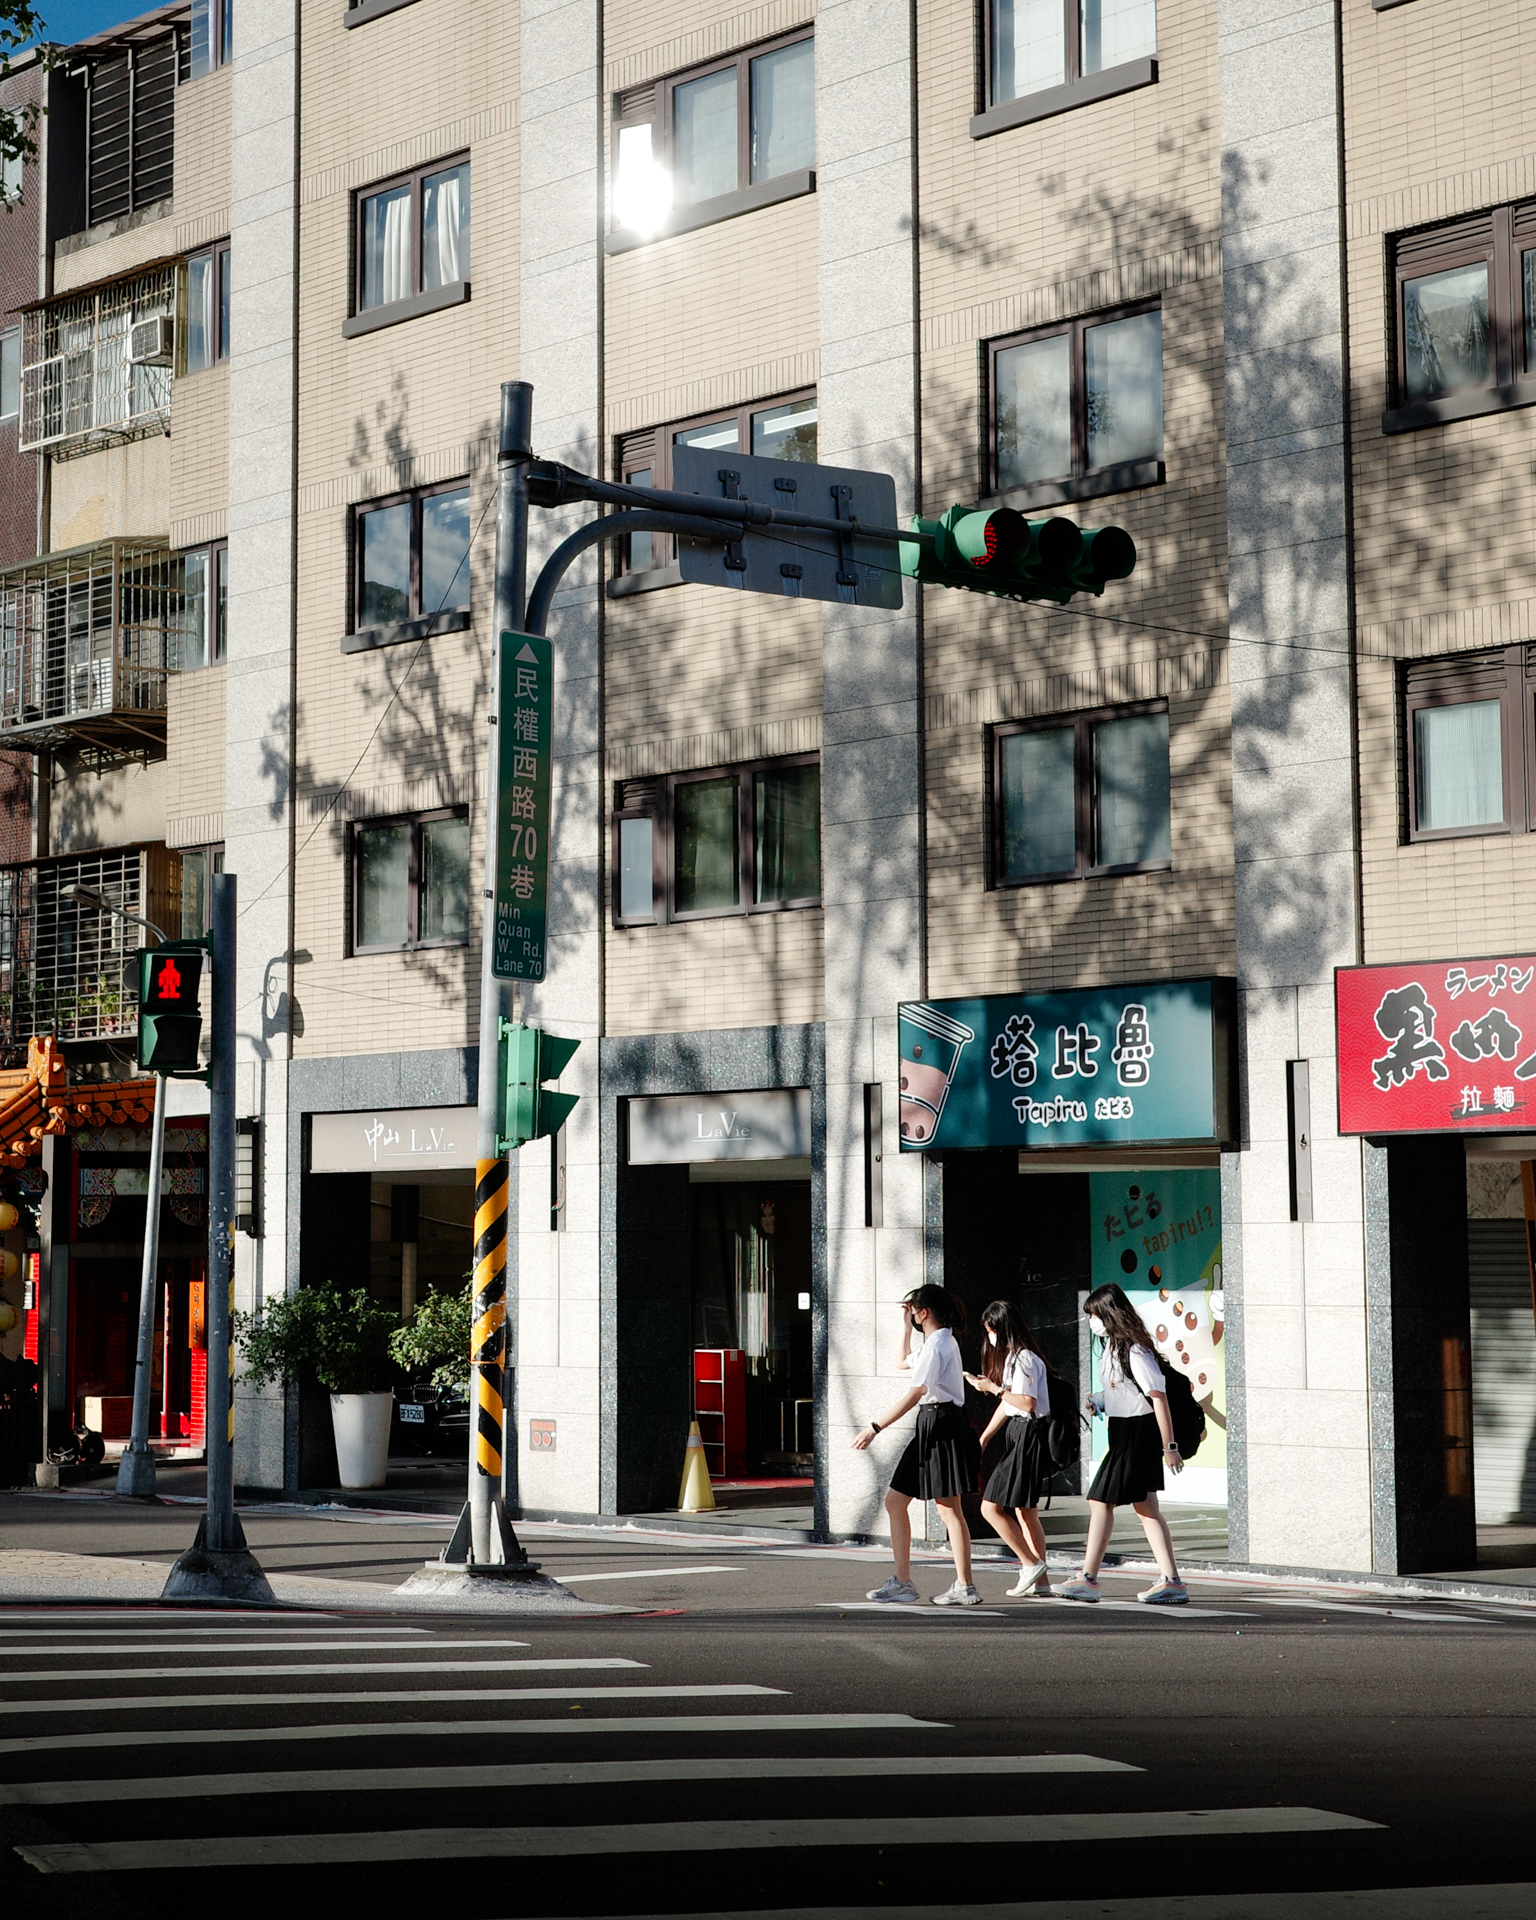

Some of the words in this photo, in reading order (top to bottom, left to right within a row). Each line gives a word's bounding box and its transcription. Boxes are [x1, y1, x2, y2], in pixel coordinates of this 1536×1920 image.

[510, 667, 540, 900] 民權西路70巷
[498, 902, 521, 919] Min
[498, 920, 531, 939] Quan
[497, 938, 513, 954] W.
[523, 941, 542, 958] Rd.
[496, 955, 524, 973] Lane
[529, 960, 542, 976] 70
[1445, 963, 1535, 1000] ラーメン
[990, 1003, 1154, 1088] 塔比魯
[1012, 1095, 1087, 1128] Tapiru
[1460, 1085, 1515, 1115] 拉麵
[364, 1117, 400, 1164] 中山
[696, 1112, 750, 1138] LaVie
[1142, 1205, 1214, 1256] tapiru!?
